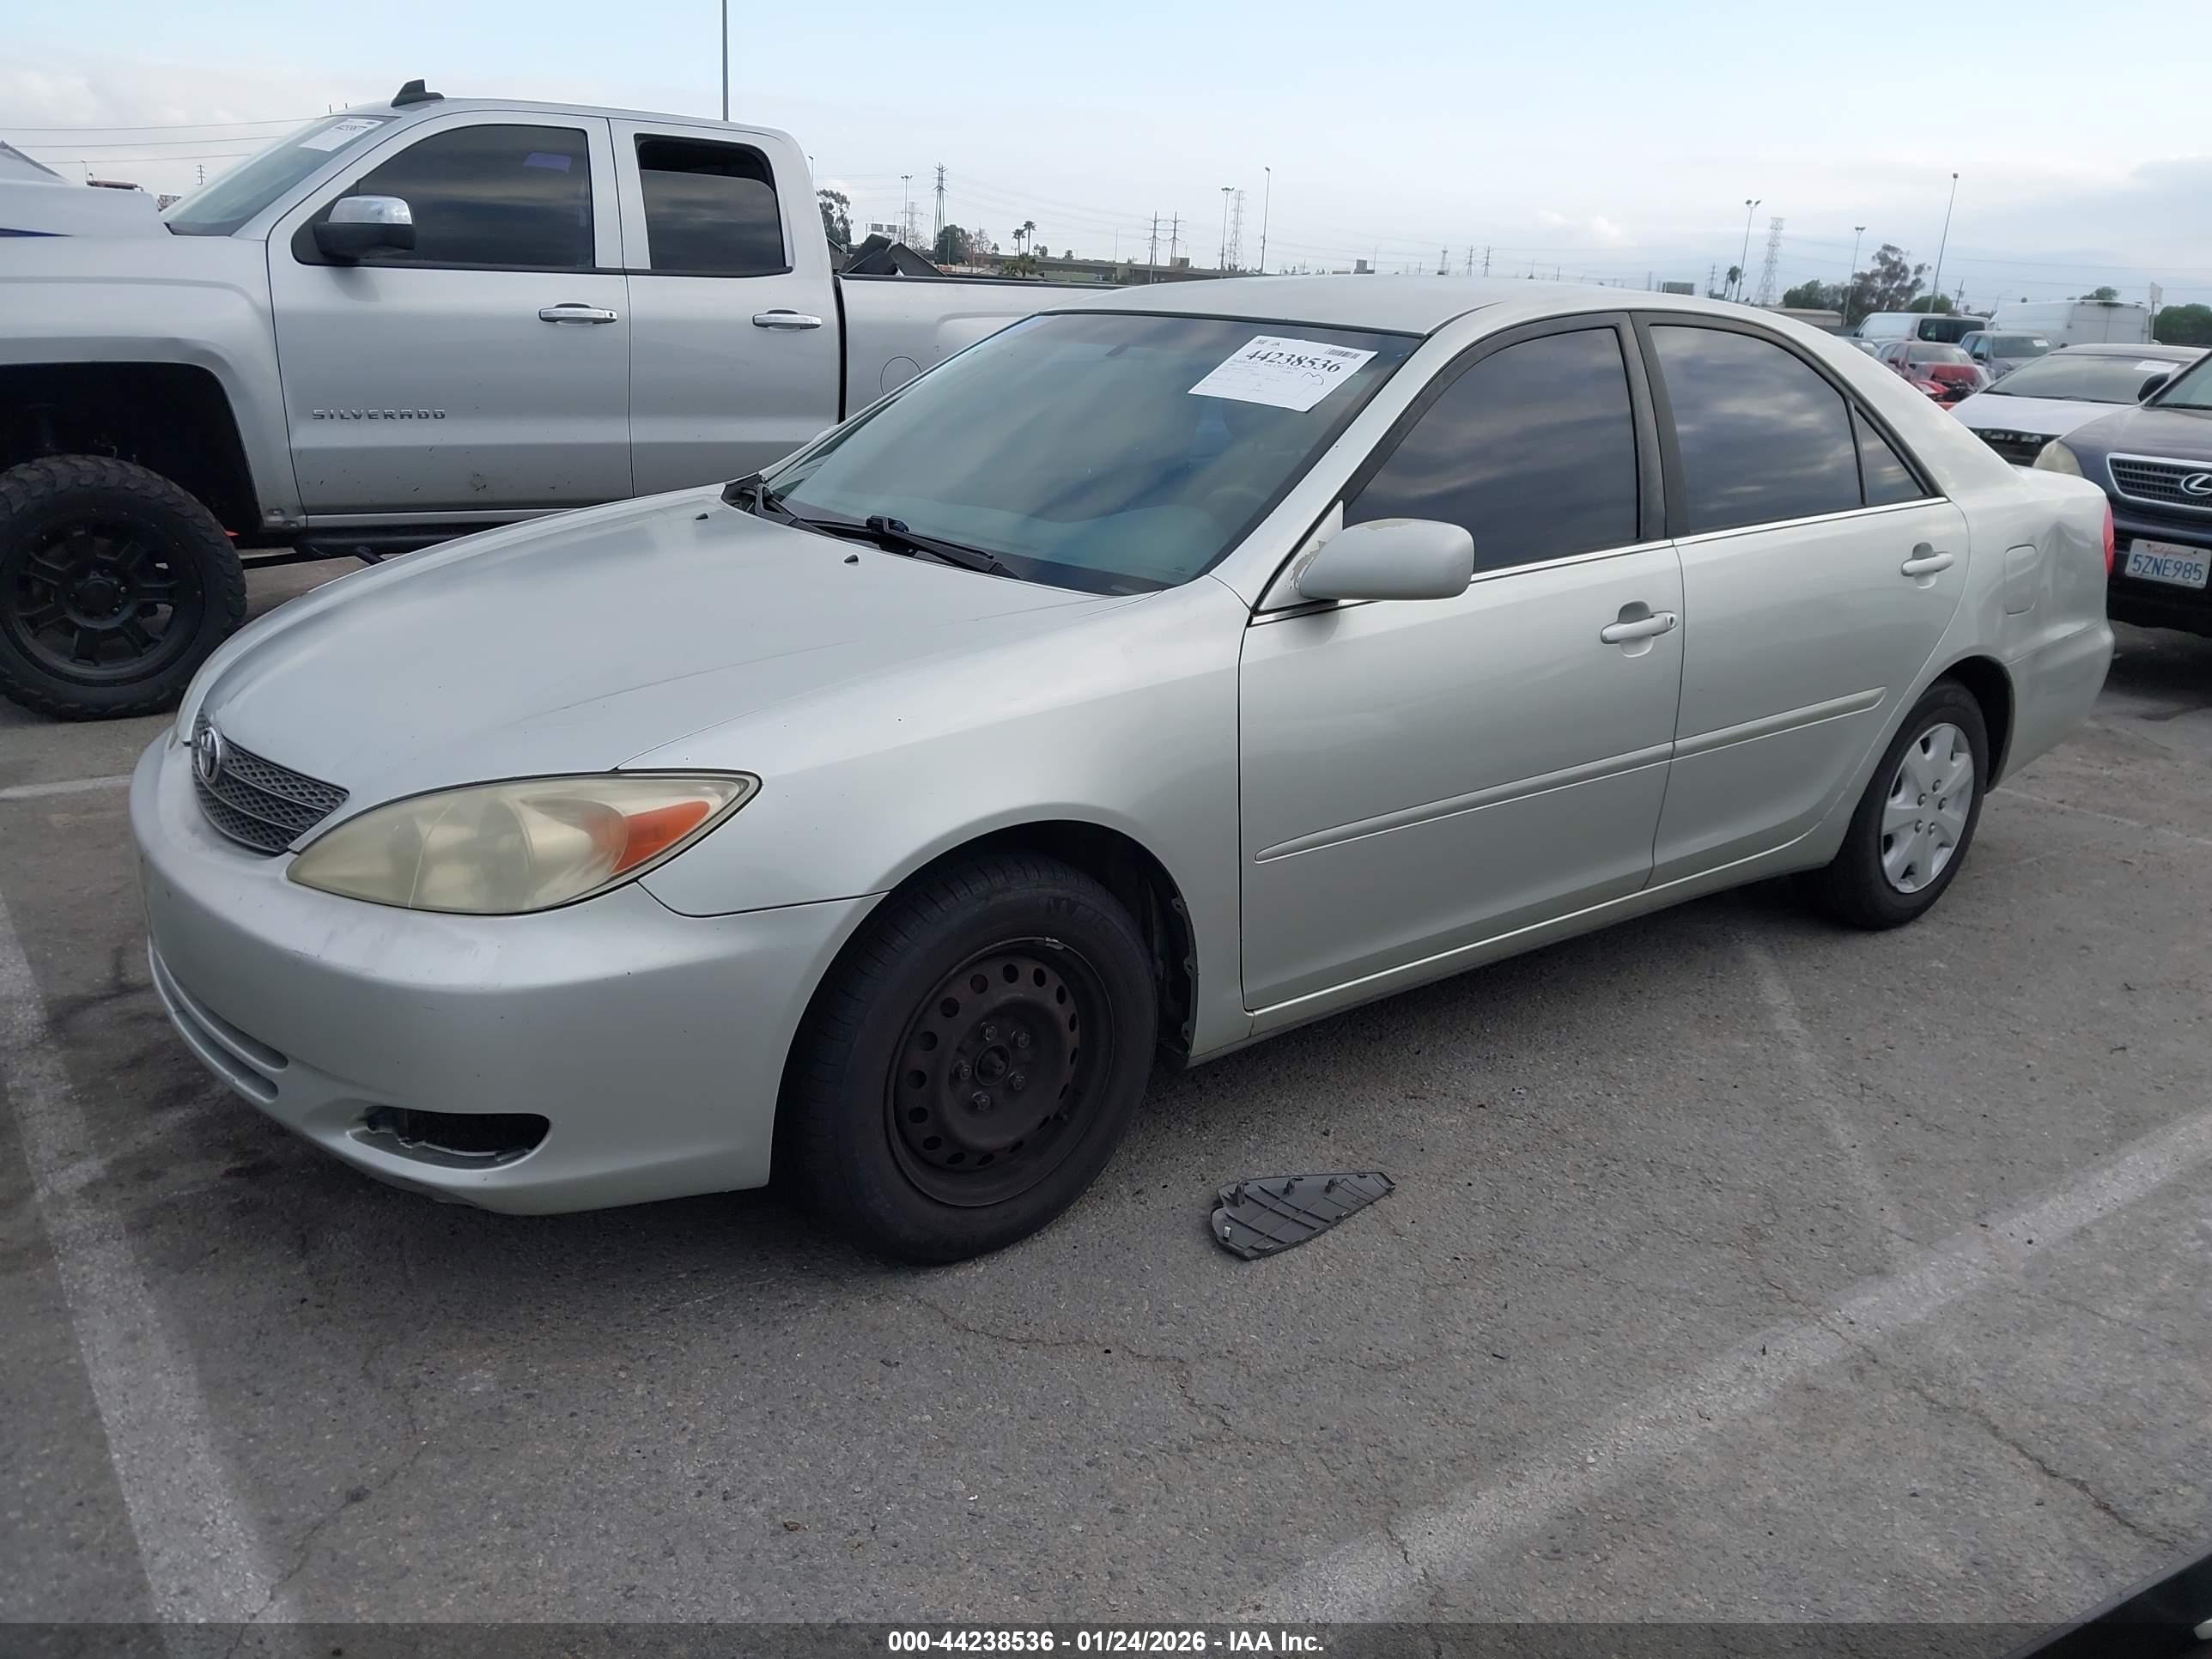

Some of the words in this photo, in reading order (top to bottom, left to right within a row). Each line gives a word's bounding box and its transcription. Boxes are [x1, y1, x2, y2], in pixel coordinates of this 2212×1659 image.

[1245, 349, 1346, 373] 44238536
[313, 409, 447, 420] SILVERADO
[2132, 554, 2204, 581] 5ZNE985
